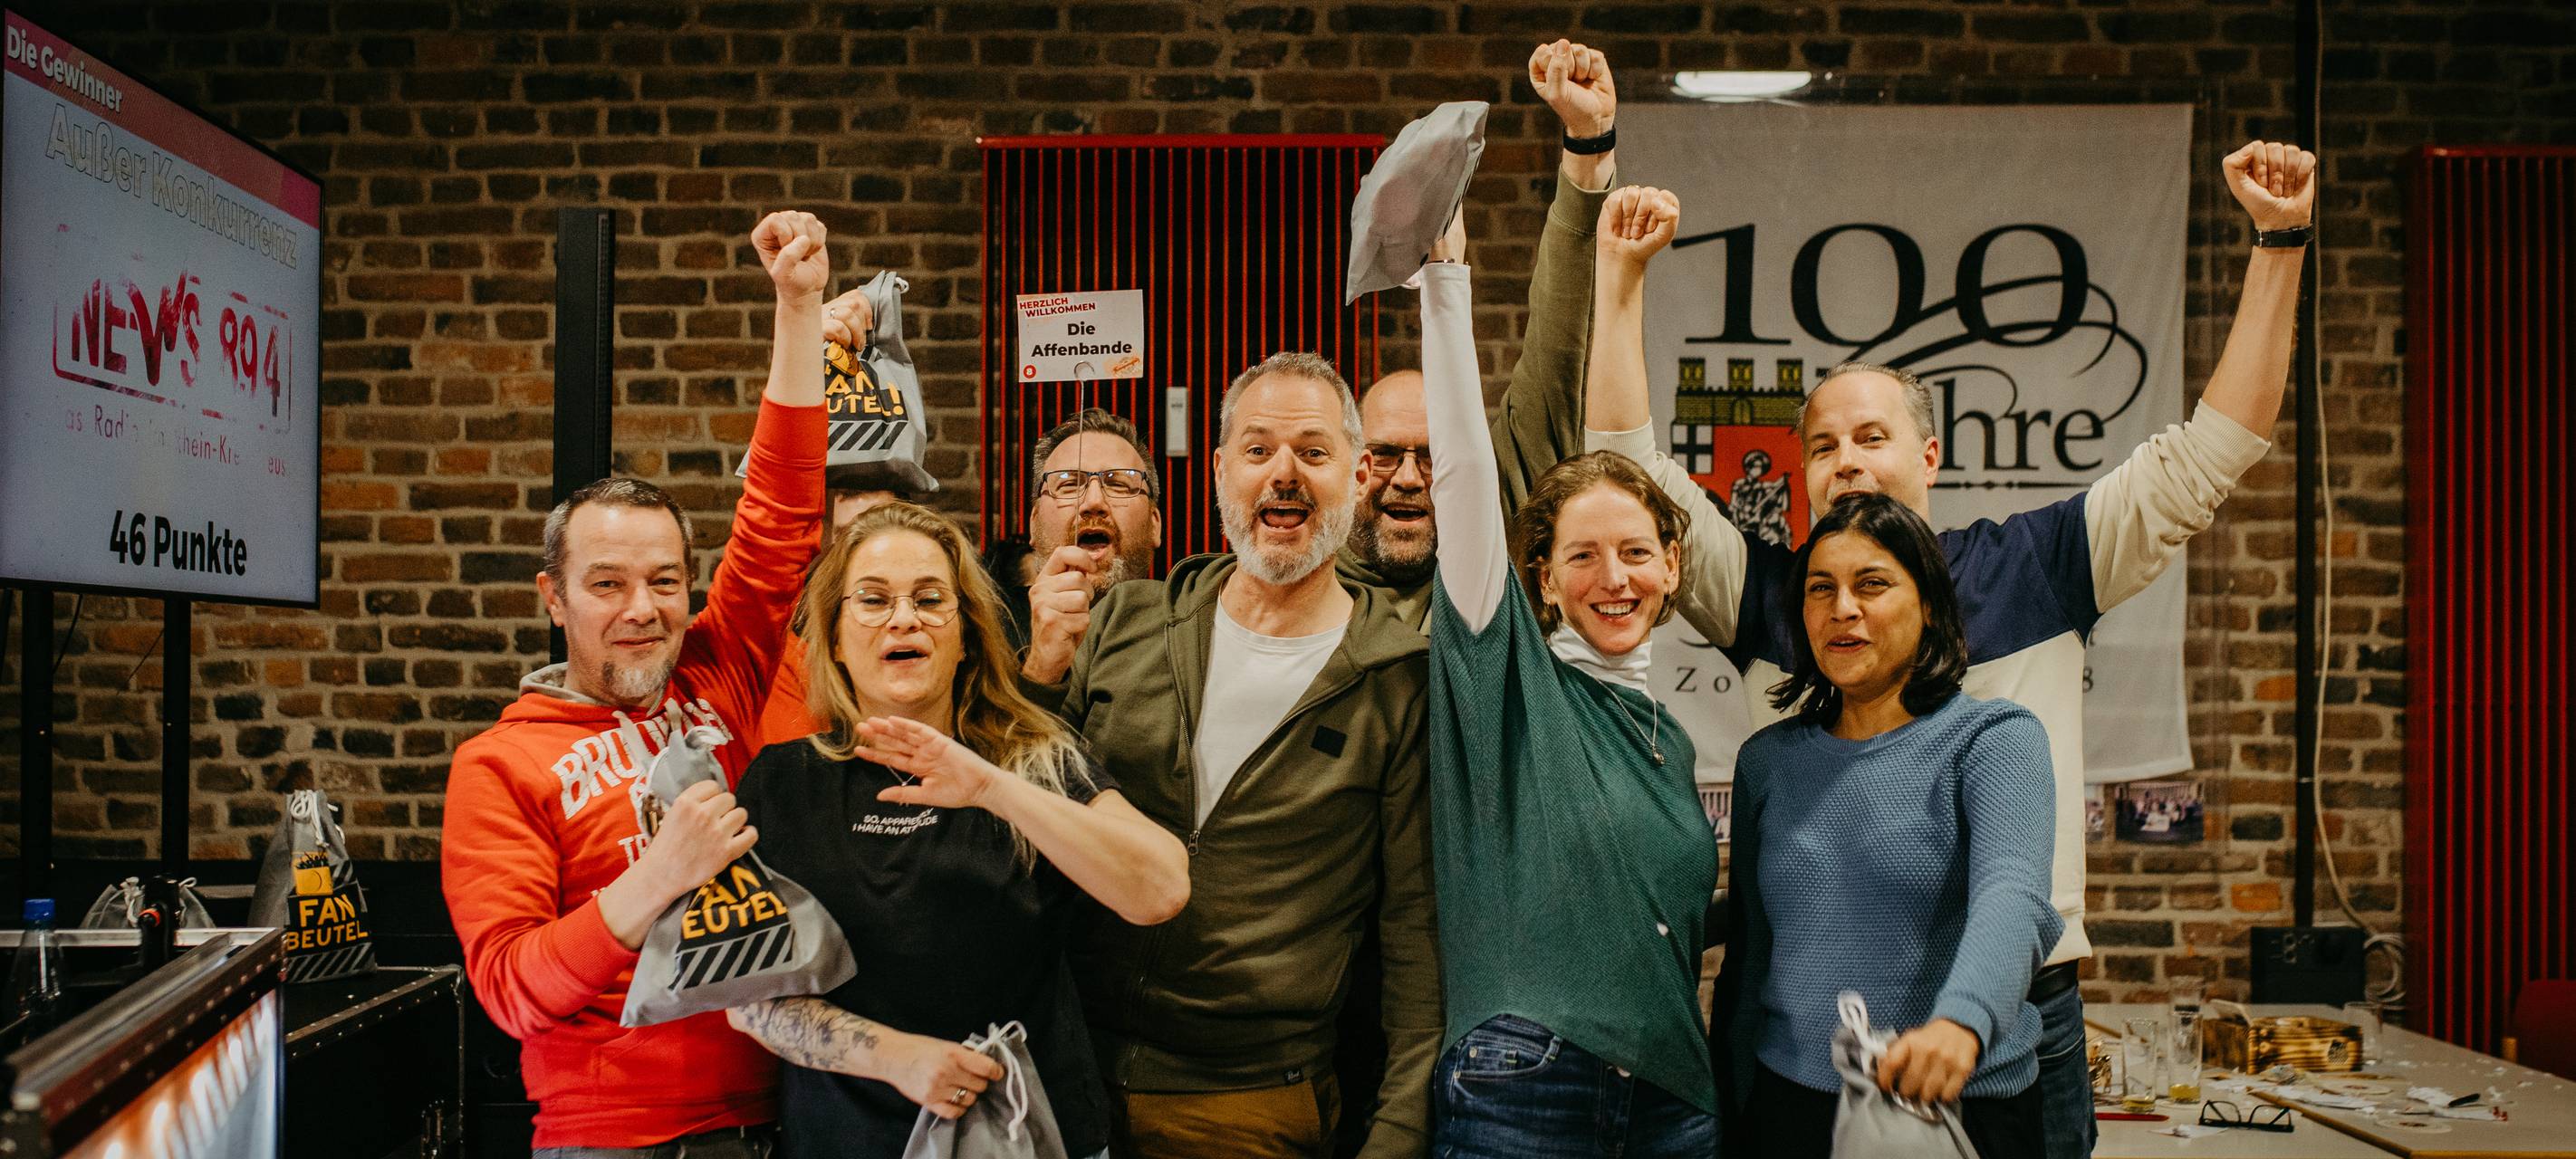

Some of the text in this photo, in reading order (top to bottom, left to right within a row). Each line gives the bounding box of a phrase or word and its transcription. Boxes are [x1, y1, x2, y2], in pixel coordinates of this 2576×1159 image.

[7, 25, 123, 113] Die Gewinner
[45, 103, 297, 270] Außer Konkurrenz
[1671, 224, 2089, 348] 100
[1019, 297, 1068, 310] HERZLICH
[1025, 302, 1095, 318] WILLKOMMEN
[1067, 321, 1096, 336] Die
[1031, 341, 1132, 357] Affenbande
[825, 364, 874, 396] AN
[1936, 378, 2106, 472] hre
[110, 510, 247, 577] 46 Punkte
[857, 823, 885, 834] HAVE
[884, 826, 899, 836] AN
[690, 865, 762, 911] AN
[299, 894, 356, 928] FAN
[681, 891, 788, 940] EUTEL
[286, 920, 369, 952] BEUTEL
